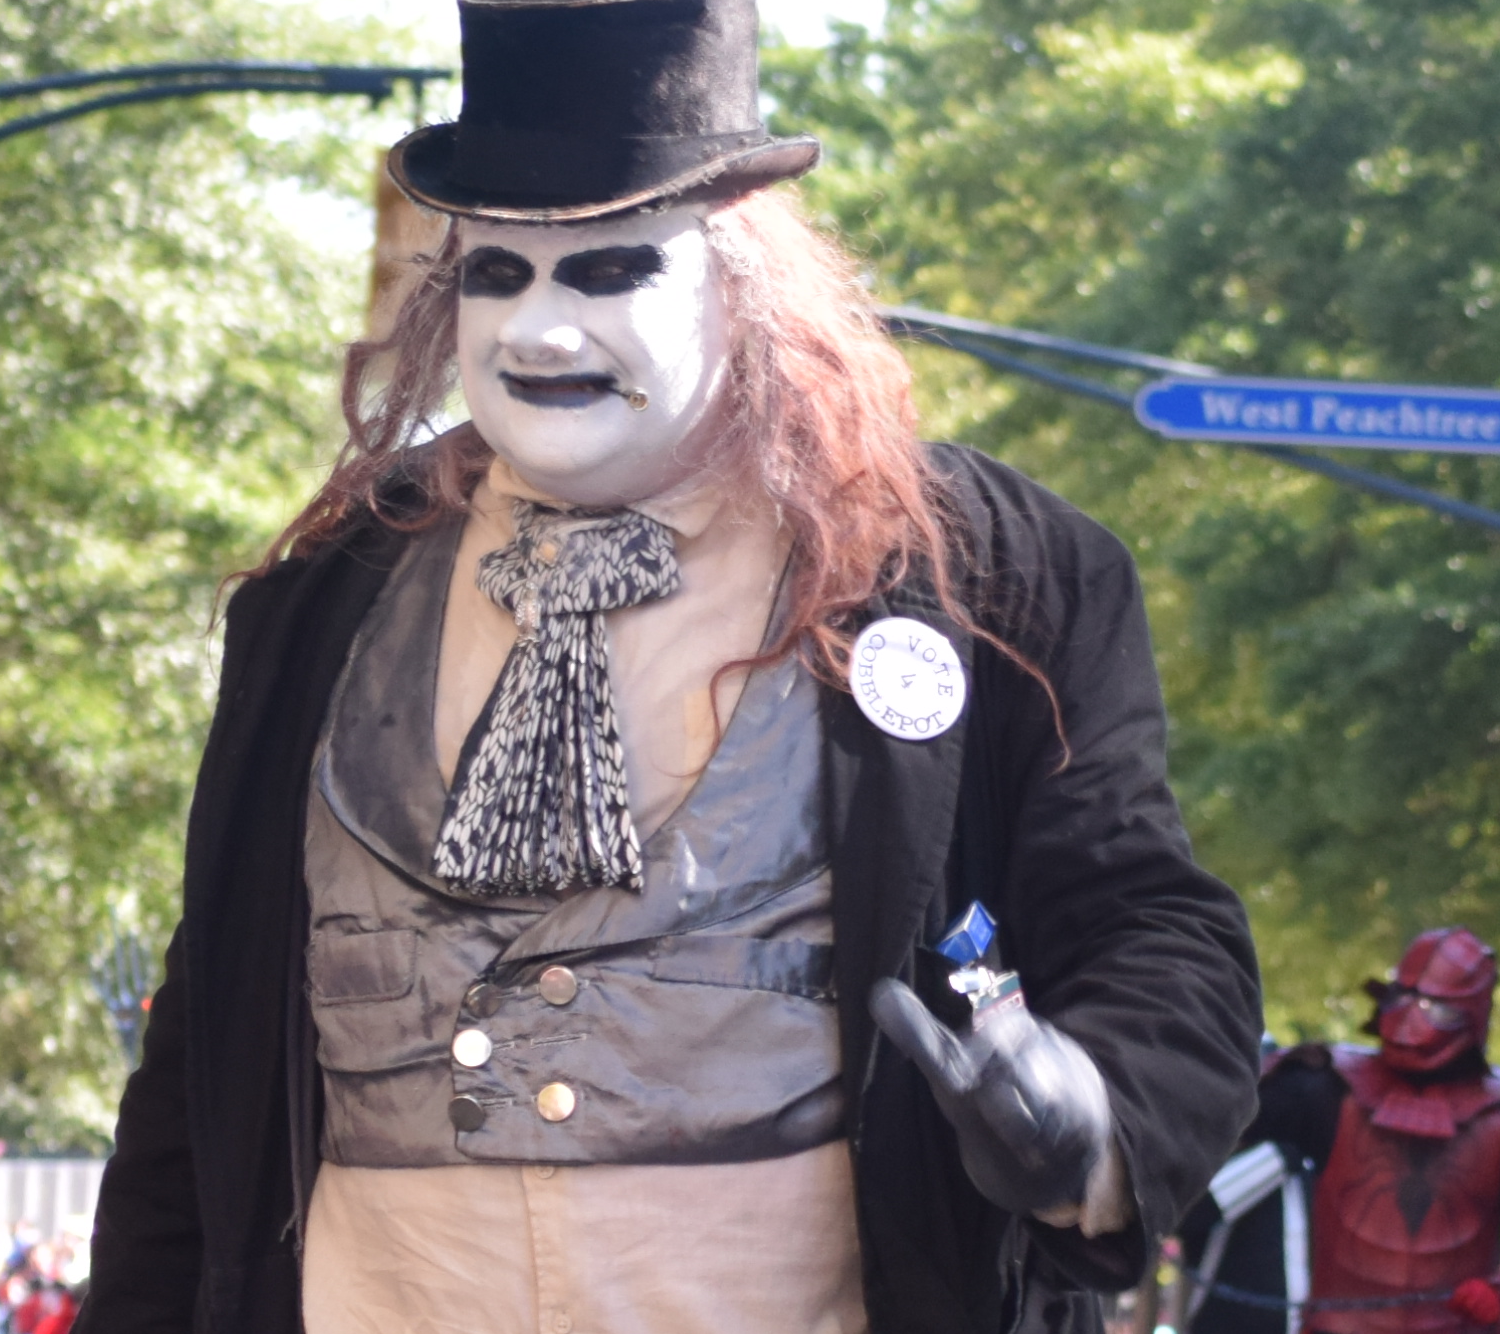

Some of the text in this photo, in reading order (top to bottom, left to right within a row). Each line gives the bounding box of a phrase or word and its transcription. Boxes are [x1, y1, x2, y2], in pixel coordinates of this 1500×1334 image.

[1202, 391, 1299, 430] West
[857, 633, 945, 734] COBBLEPOT
[900, 673, 917, 689] 4
[908, 635, 954, 697] VOTE
